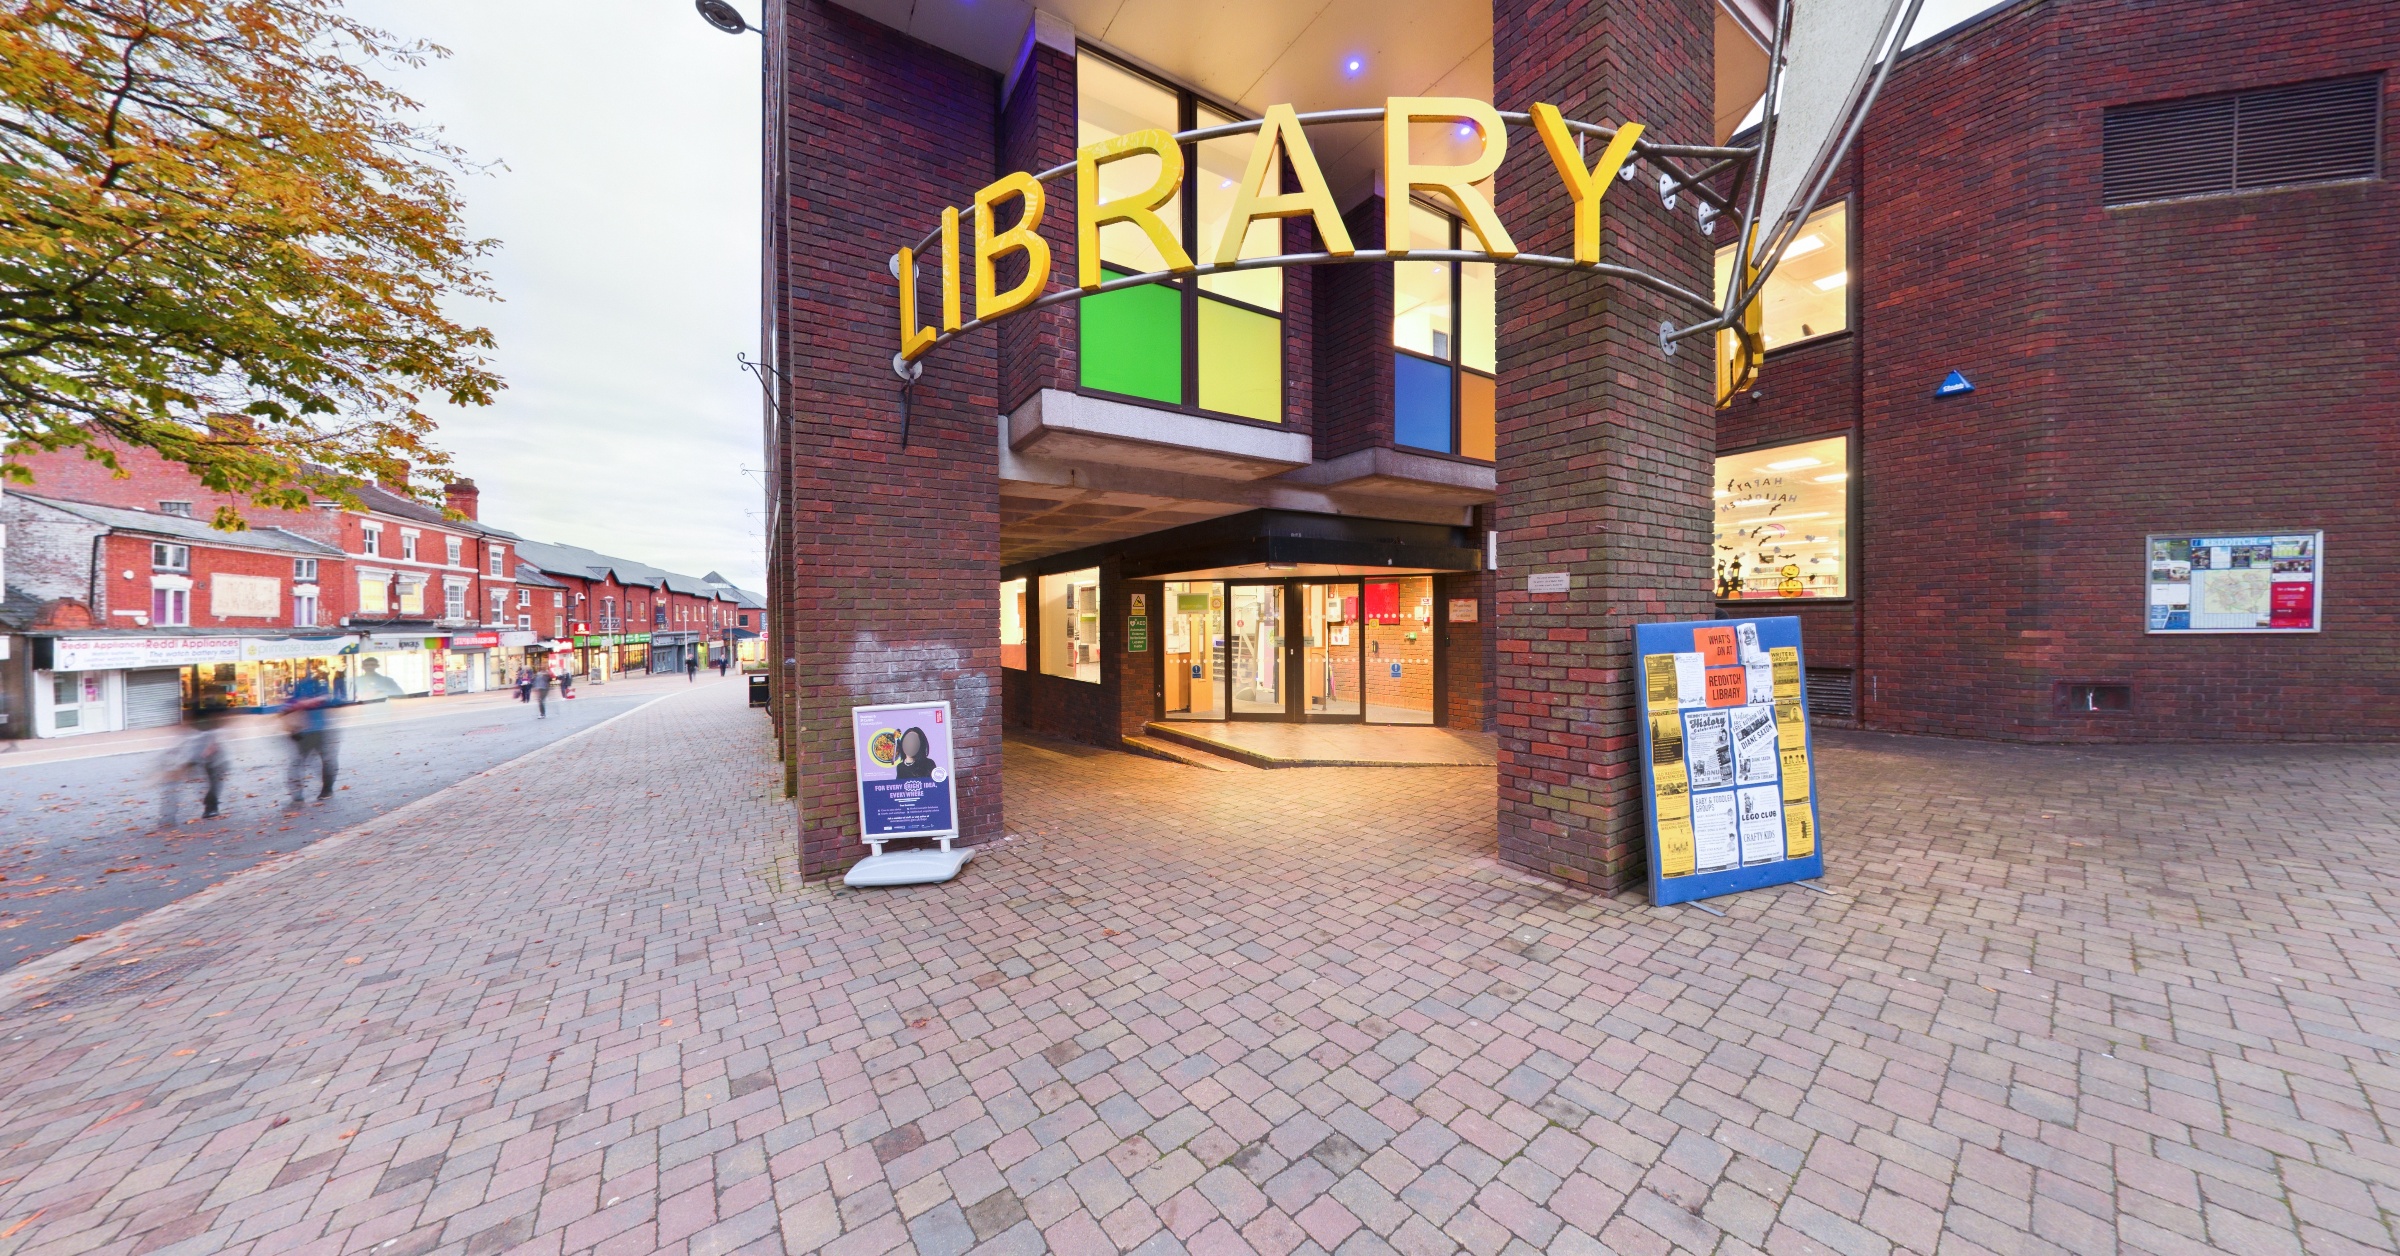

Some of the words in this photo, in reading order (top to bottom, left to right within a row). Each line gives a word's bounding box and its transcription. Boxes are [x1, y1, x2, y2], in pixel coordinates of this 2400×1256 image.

[898, 96, 1646, 361] LIBRARY
[2204, 538, 2258, 546] REDDITCH
[61, 642, 90, 650] Reddi
[93, 640, 145, 649] Appliances
[145, 639, 178, 649] Reddi
[181, 638, 239, 649] Appliances
[1708, 635, 1731, 645] WHAT'S
[257, 643, 300, 656] primrose
[302, 641, 338, 653] hospice
[1717, 646, 1725, 656] ON
[1726, 645, 1733, 655] AT
[1708, 673, 1742, 687] REDDITCH
[1712, 687, 1741, 700] LIBRARY
[1689, 716, 1726, 729] History
[1740, 734, 1758, 750] DIANE
[1756, 723, 1774, 739] SAXON
[1696, 797, 1707, 805] BABY
[1713, 794, 1733, 804] TODDLER
[1696, 804, 1715, 812] GROUPS
[1741, 812, 1760, 821] LEGO
[1760, 810, 1777, 819] CLUB
[1743, 831, 1763, 842] CRAFTY
[1763, 830, 1776, 840] KIDS
